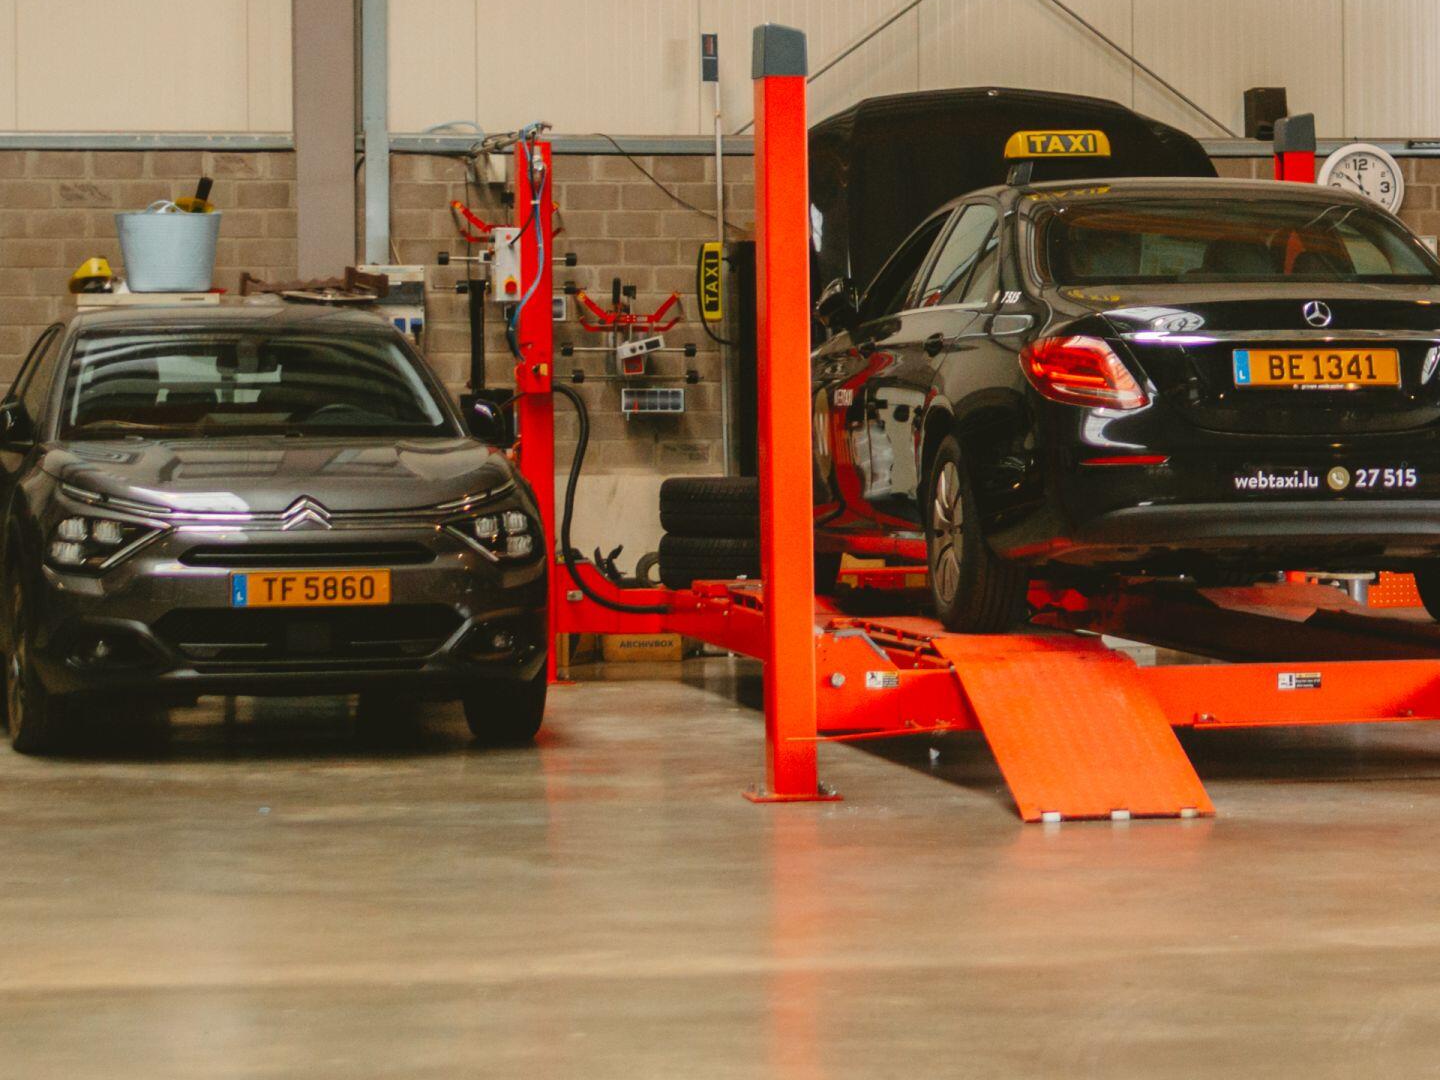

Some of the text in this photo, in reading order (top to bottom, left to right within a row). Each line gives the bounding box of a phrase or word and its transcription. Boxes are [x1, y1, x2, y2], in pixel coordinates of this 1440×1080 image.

[1030, 135, 1095, 152] TAXI
[1353, 158, 1368, 171] 12
[1380, 181, 1390, 194] 3
[705, 258, 719, 305] TAXI
[1238, 370, 1246, 381] L
[1268, 353, 1378, 381] BE 1341
[1235, 468, 1417, 489] webtaxi.lu 27 515
[263, 575, 375, 601] TF 5860
